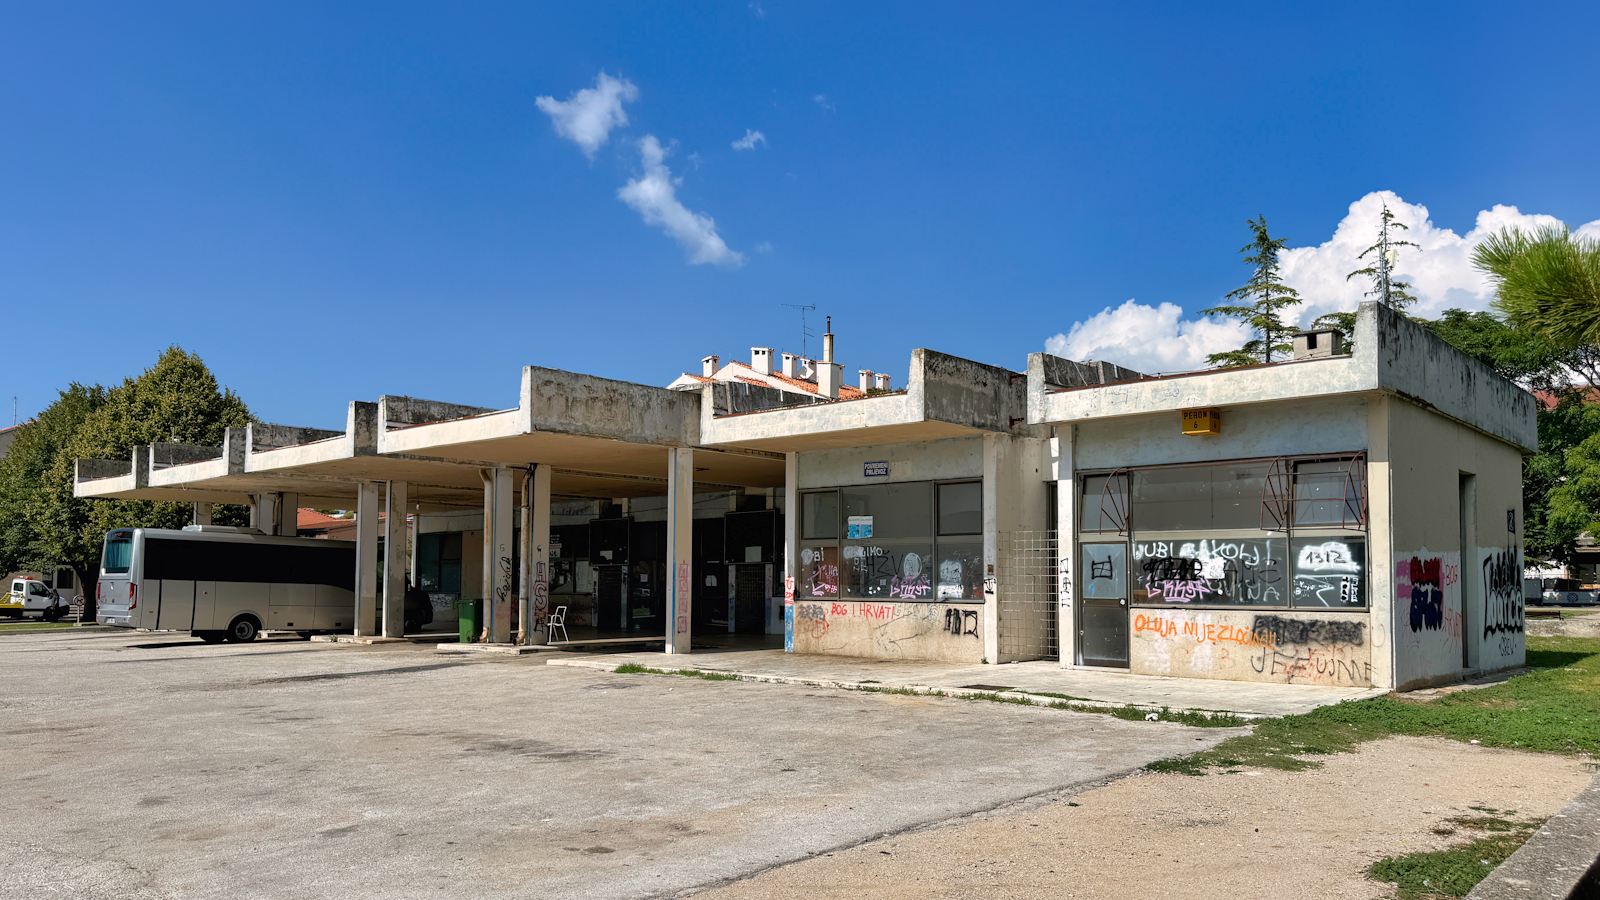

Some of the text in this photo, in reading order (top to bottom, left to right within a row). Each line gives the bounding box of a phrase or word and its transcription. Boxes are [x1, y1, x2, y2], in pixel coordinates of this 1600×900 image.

[1184, 411, 1207, 420] PERON
[1193, 420, 1198, 429] 6
[1305, 550, 1348, 564] 1312
[831, 603, 848, 616] BOG
[859, 607, 895, 621] HRVATI
[1134, 614, 1178, 638] OLUJA
[1184, 621, 1216, 643] NIJE
